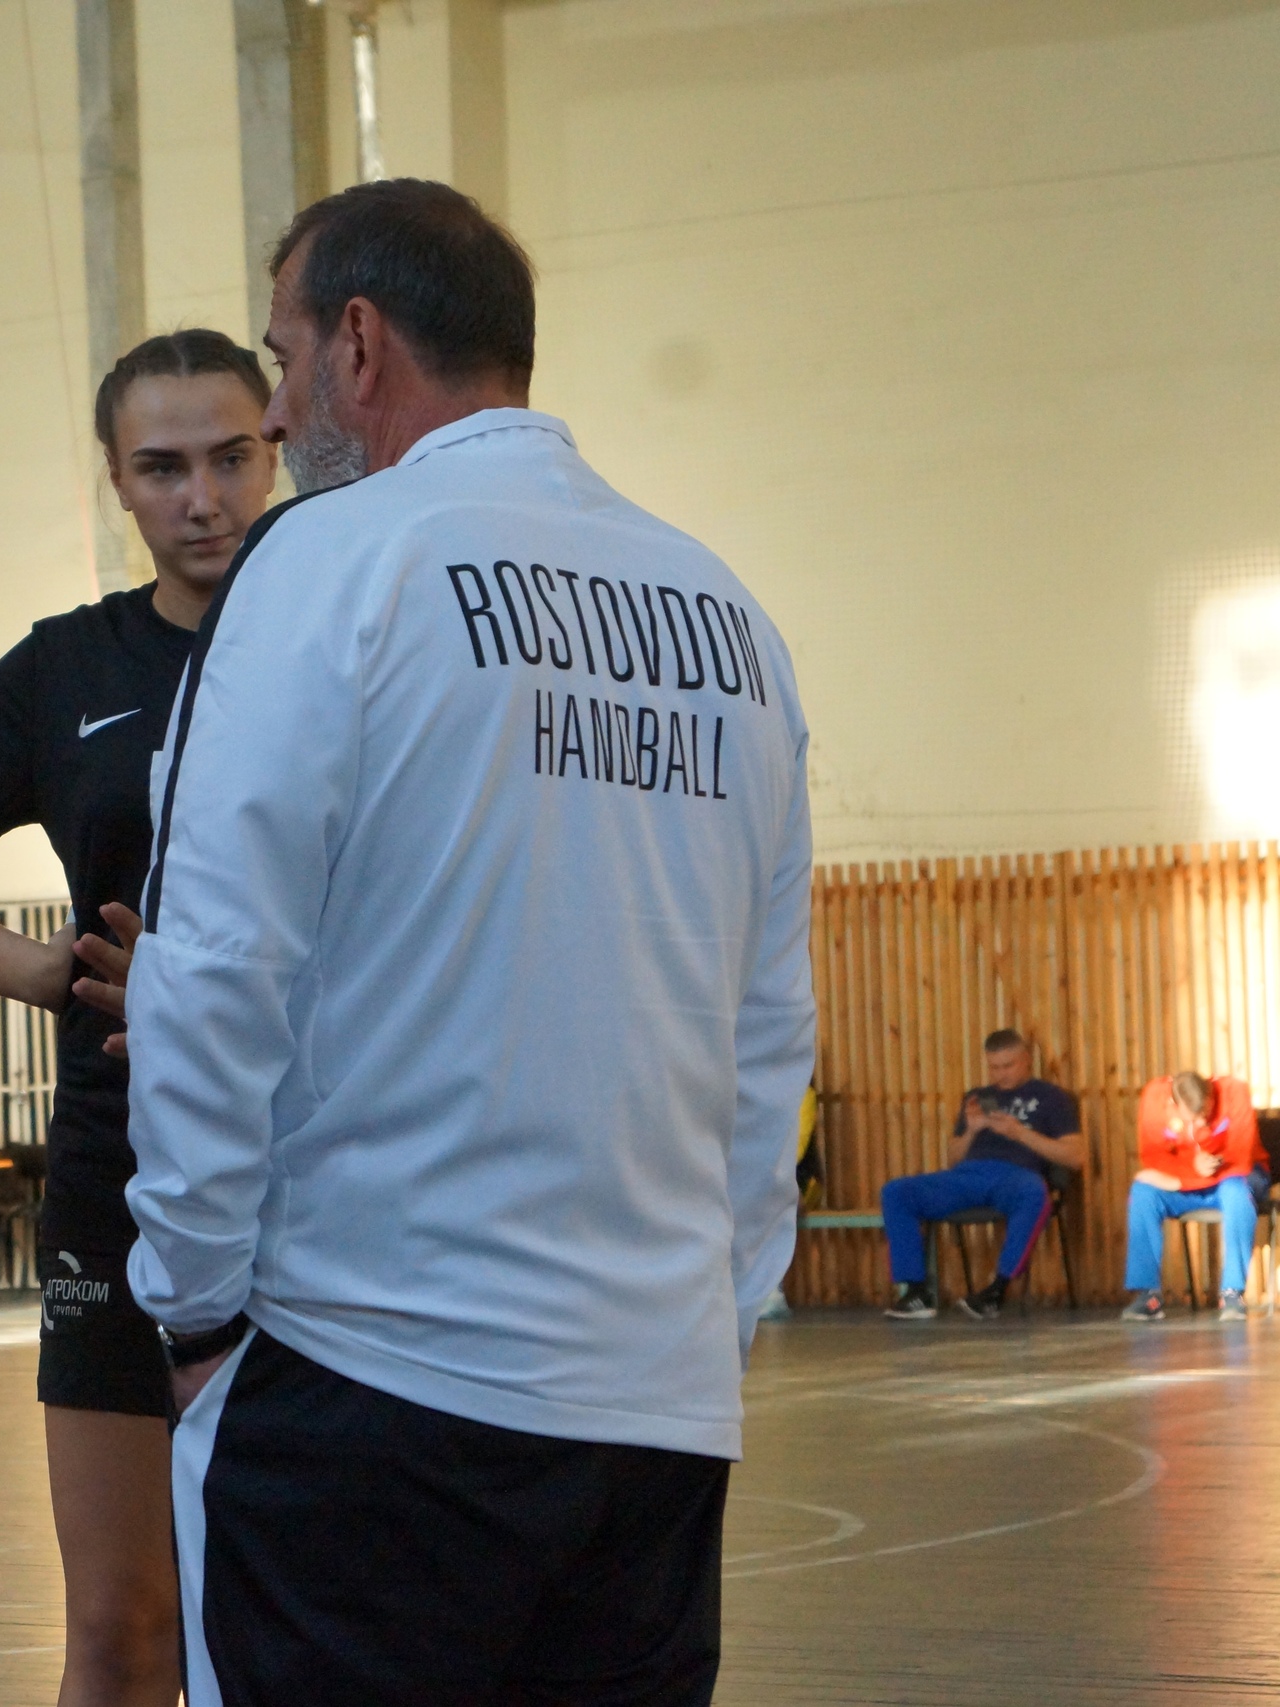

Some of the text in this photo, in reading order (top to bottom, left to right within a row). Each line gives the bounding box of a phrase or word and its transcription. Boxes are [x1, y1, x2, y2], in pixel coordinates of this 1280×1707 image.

[446, 559, 767, 707] ROSTOVDON
[535, 689, 727, 799] HANDBALL
[45, 1279, 110, 1303] АГРОКОМ
[52, 1305, 83, 1317] ГРУППА
